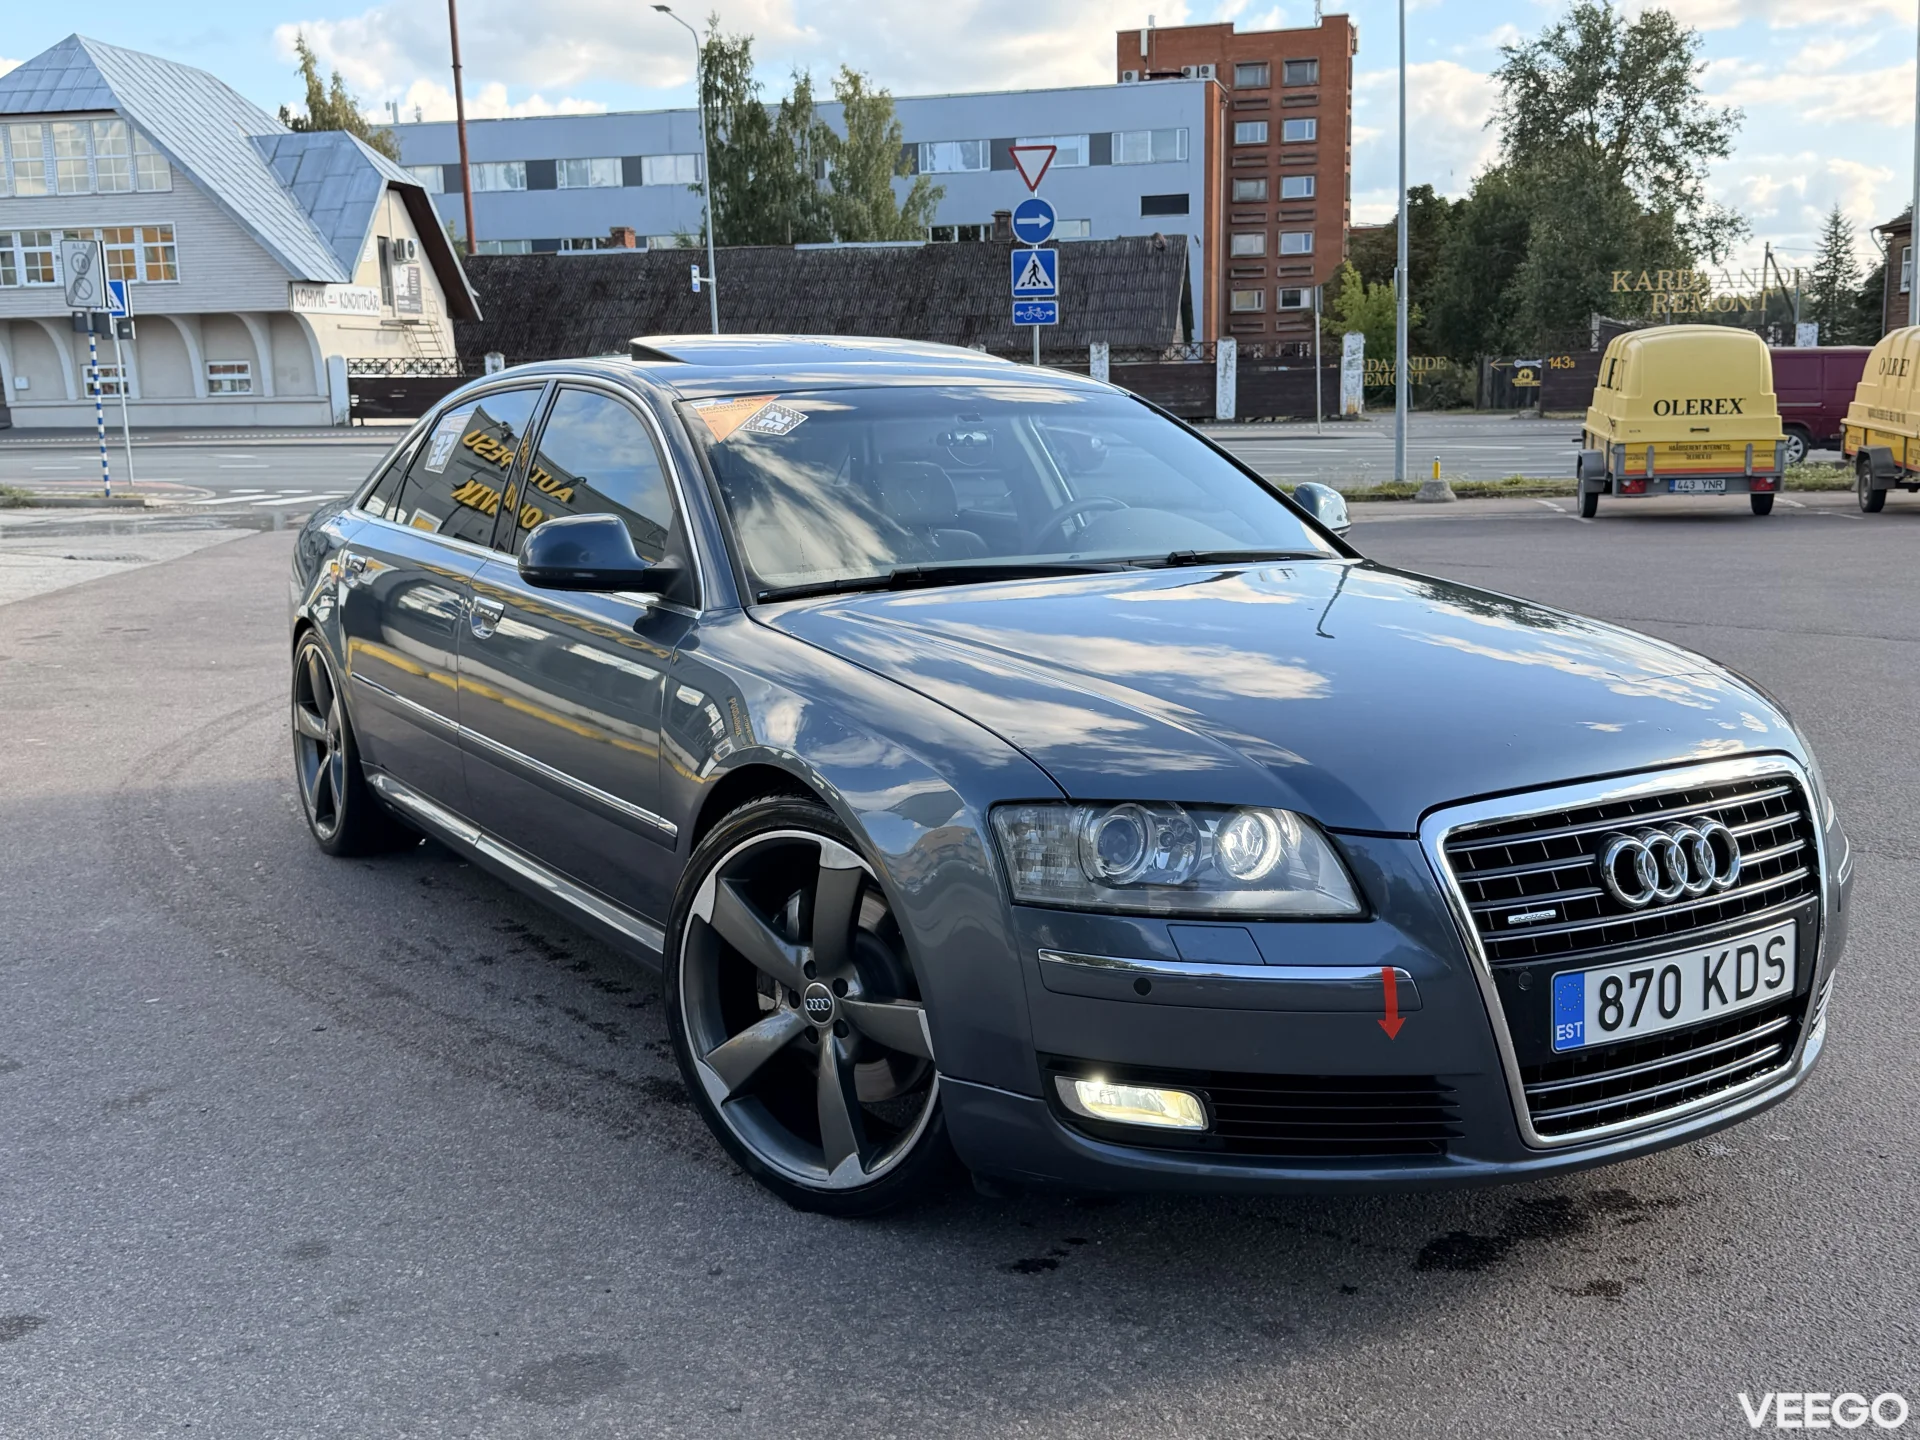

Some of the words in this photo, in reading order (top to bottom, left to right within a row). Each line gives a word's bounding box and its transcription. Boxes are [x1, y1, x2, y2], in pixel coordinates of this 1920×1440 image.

[71, 242, 87, 250] ALA
[1610, 266, 1809, 293] KARDAANIDE
[294, 288, 327, 308] KOHVIK
[1651, 289, 1775, 315] REMONT
[1362, 356, 1447, 373] DANIDE
[1653, 397, 1743, 417] OLEREX
[1677, 481, 1696, 490] 443
[1701, 480, 1723, 489] YNR
[1599, 964, 1683, 1032] 870
[1702, 935, 1786, 1011] KDS
[1556, 1021, 1584, 1041] EST
